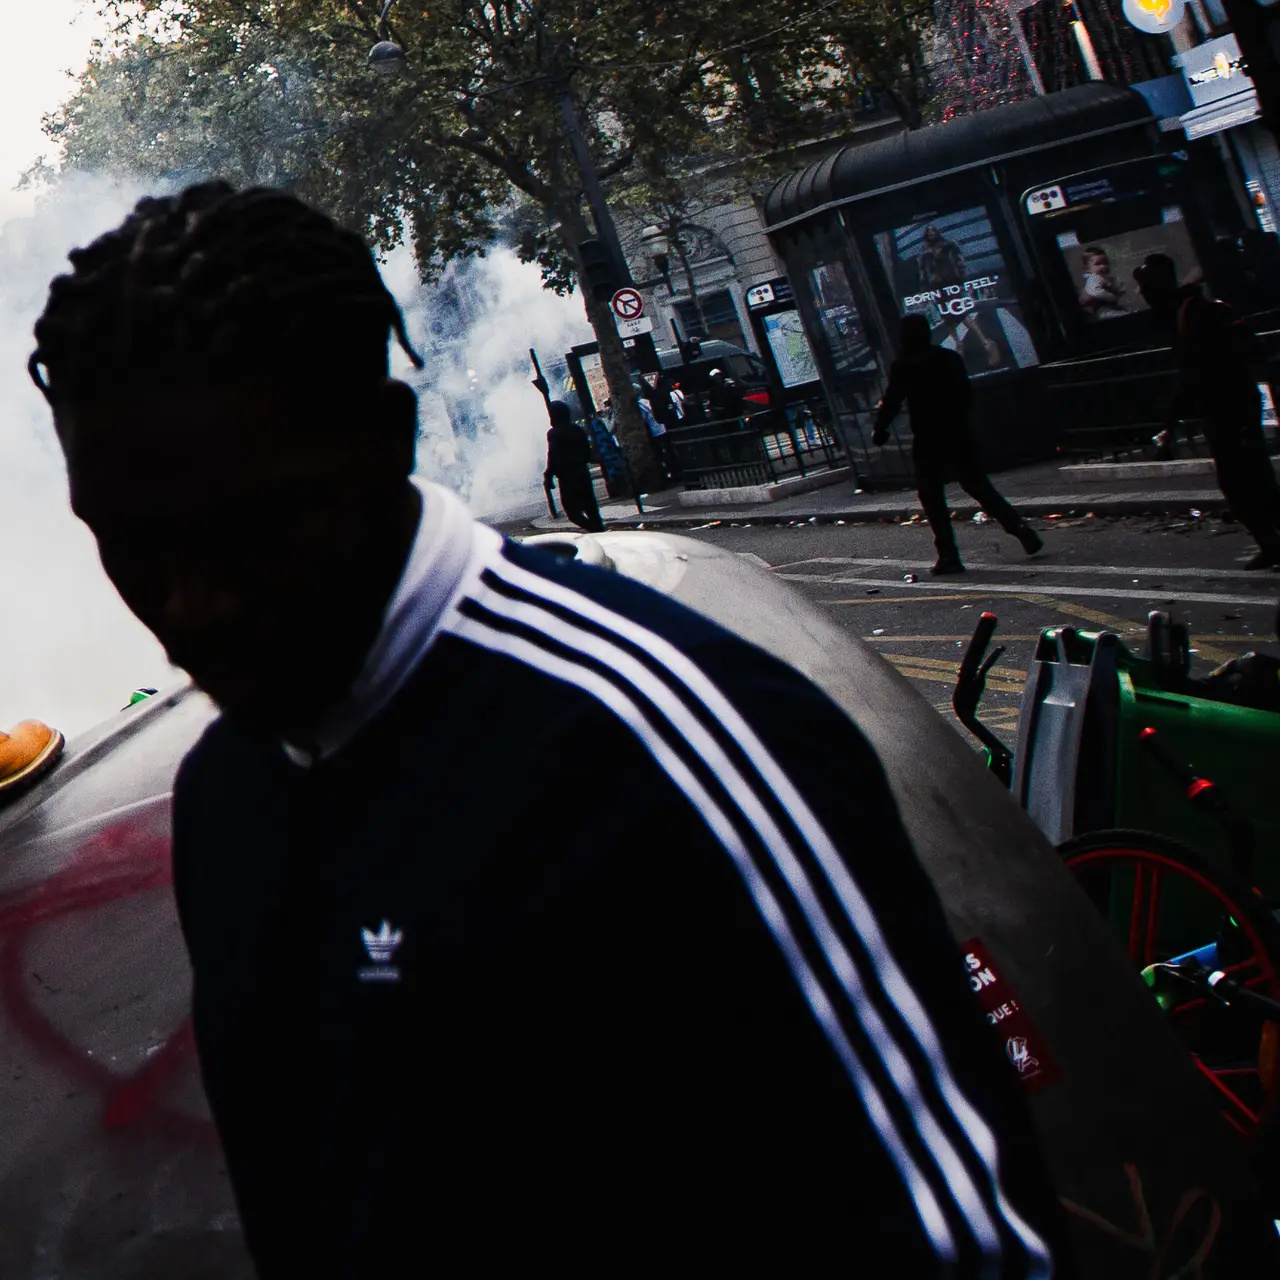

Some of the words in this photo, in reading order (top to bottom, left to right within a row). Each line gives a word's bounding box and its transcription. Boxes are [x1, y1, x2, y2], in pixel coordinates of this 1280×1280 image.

[903, 289, 941, 307] BORN
[942, 284, 960, 297] TO
[937, 297, 975, 316] UGG
